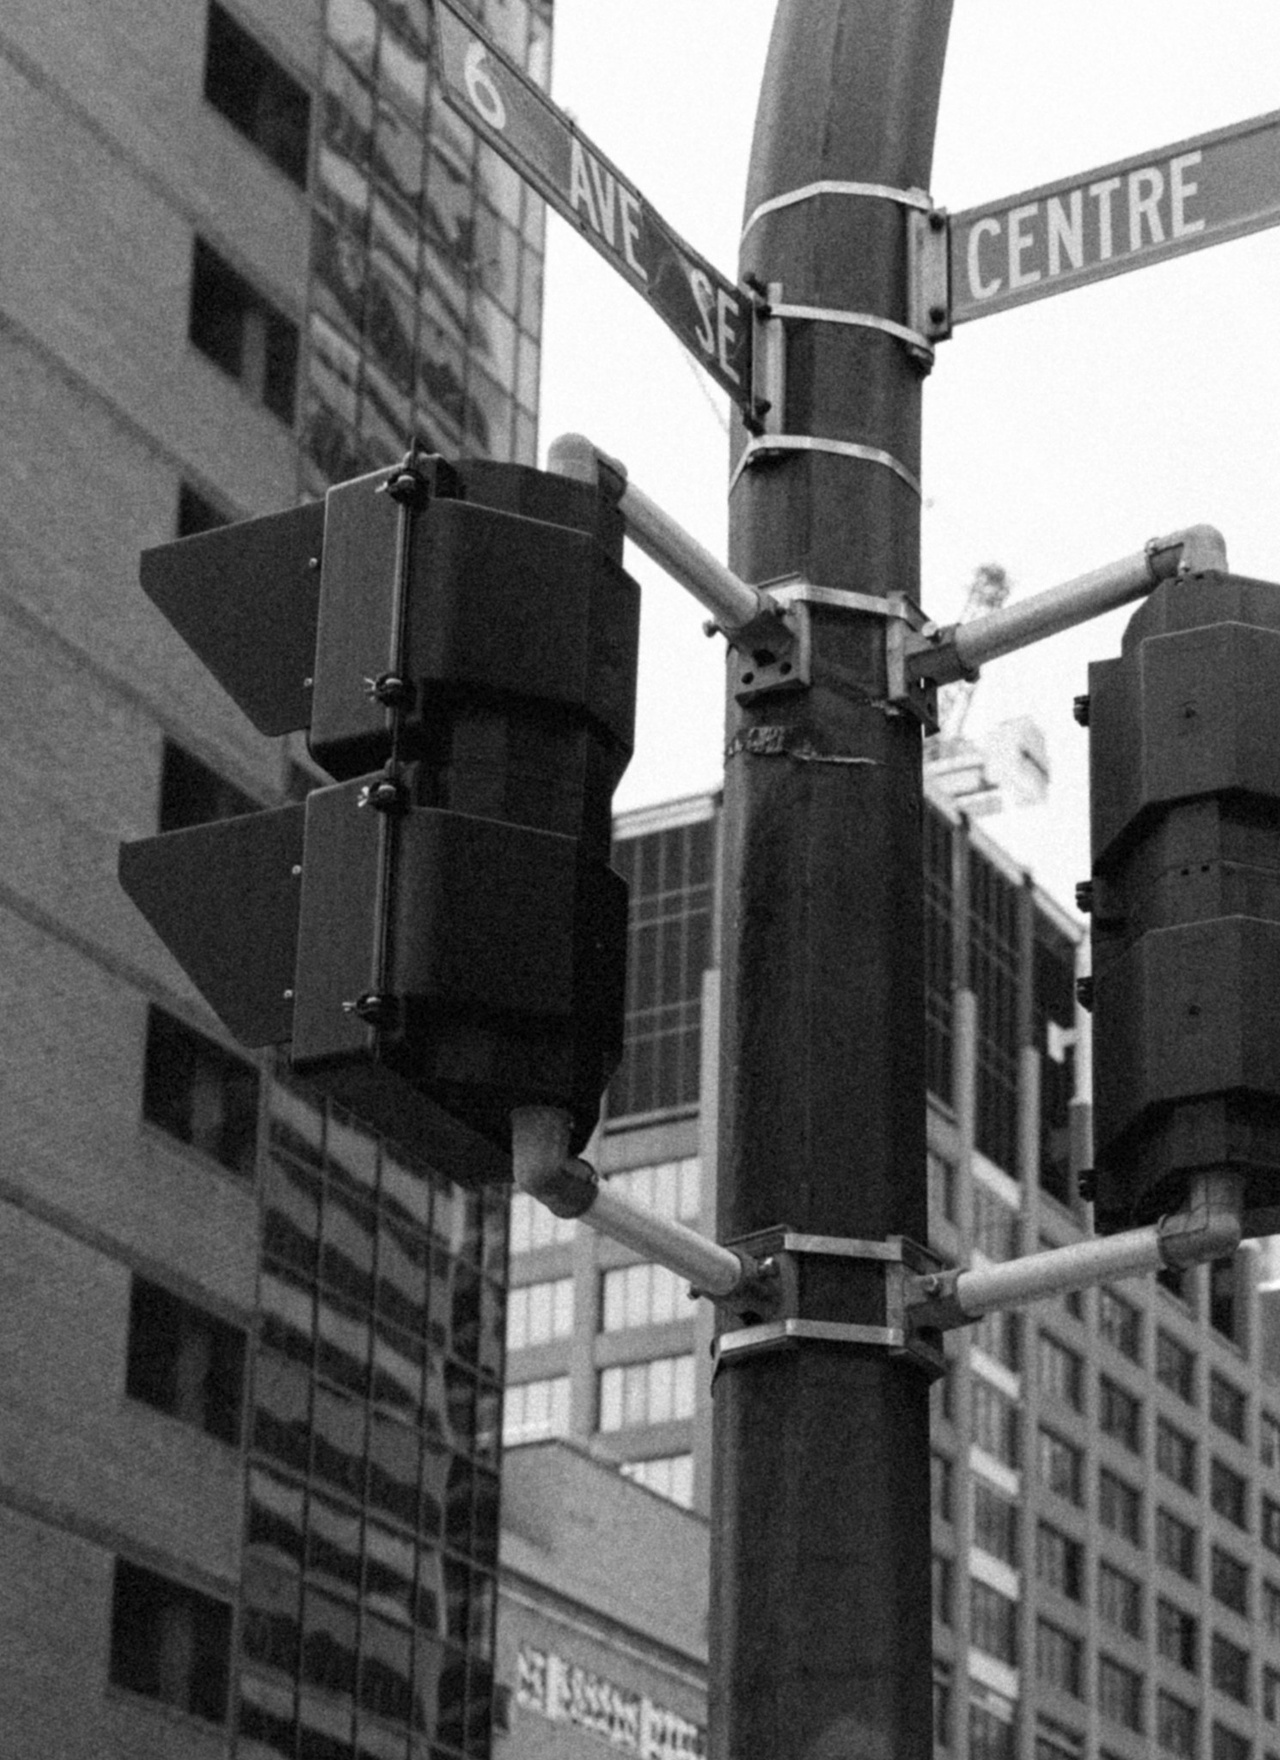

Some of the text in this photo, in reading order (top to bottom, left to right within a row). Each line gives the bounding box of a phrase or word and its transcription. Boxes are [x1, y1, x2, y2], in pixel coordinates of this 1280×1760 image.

[464, 40, 740, 385] 6 AVE SE
[967, 150, 1206, 301] CENTRE
